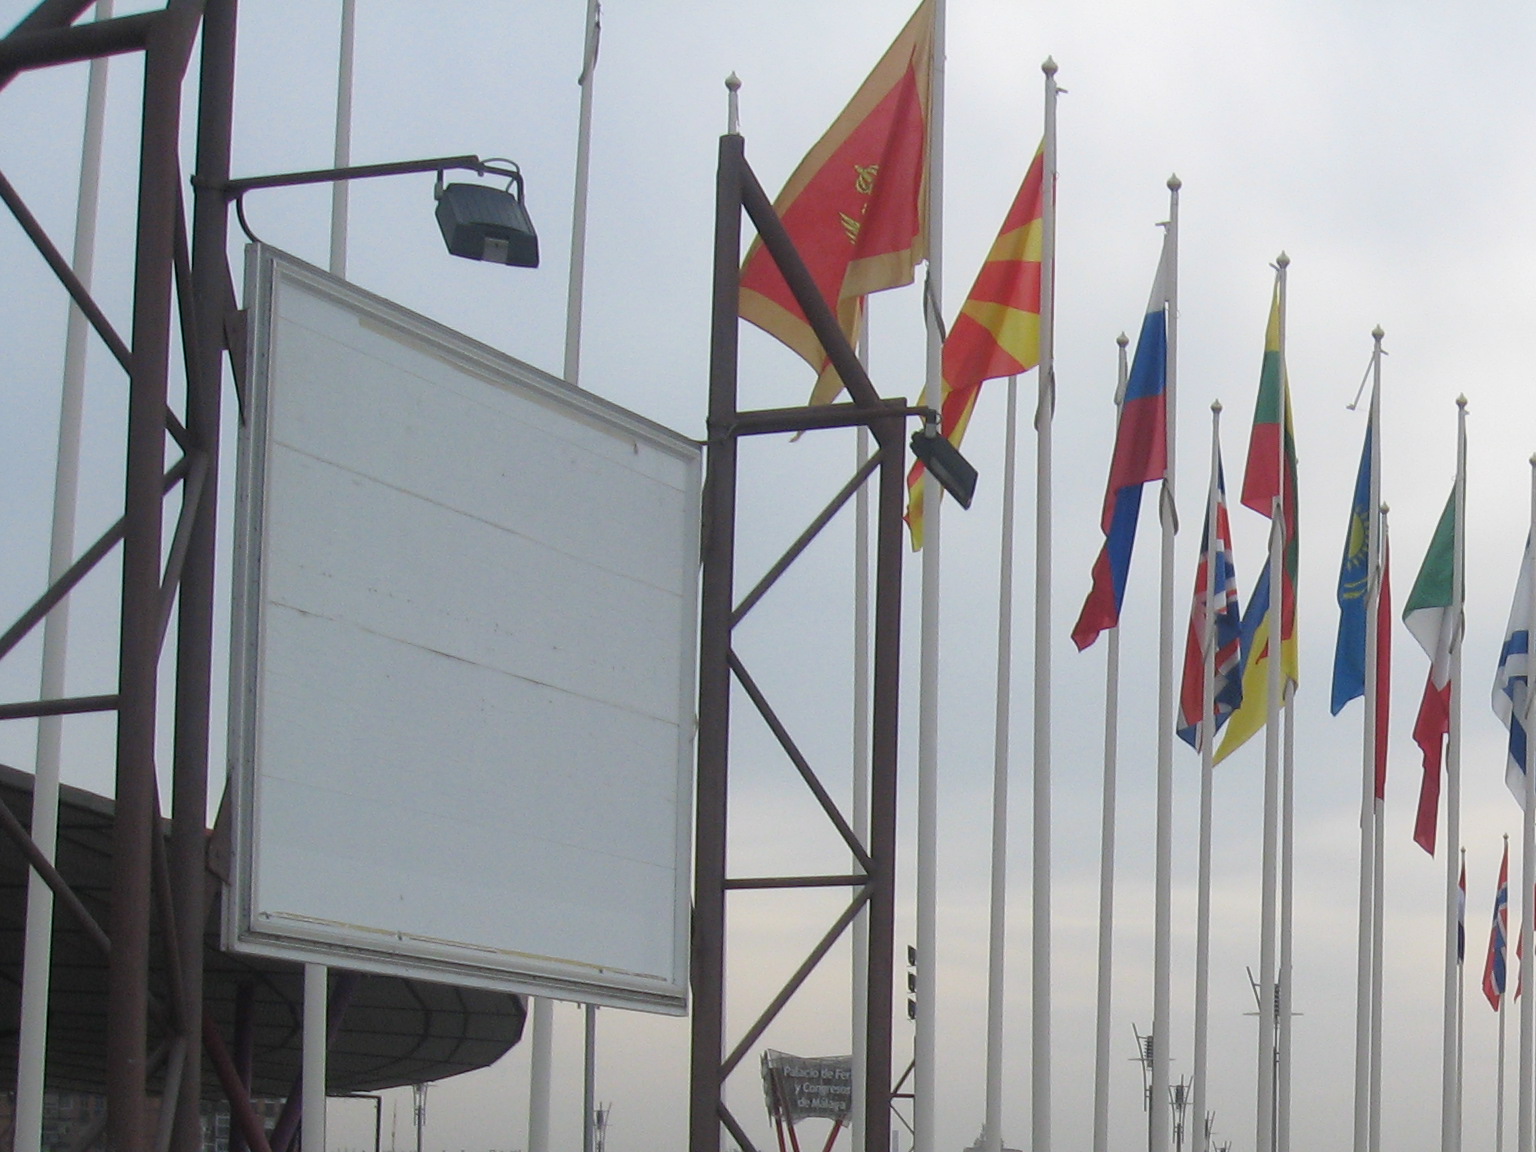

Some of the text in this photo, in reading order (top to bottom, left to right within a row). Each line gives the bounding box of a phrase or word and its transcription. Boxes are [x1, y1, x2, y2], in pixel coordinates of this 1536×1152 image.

[784, 1066, 851, 1080] Palacio de Fer
[794, 1084, 802, 1095] y
[798, 1097, 810, 1108] de
